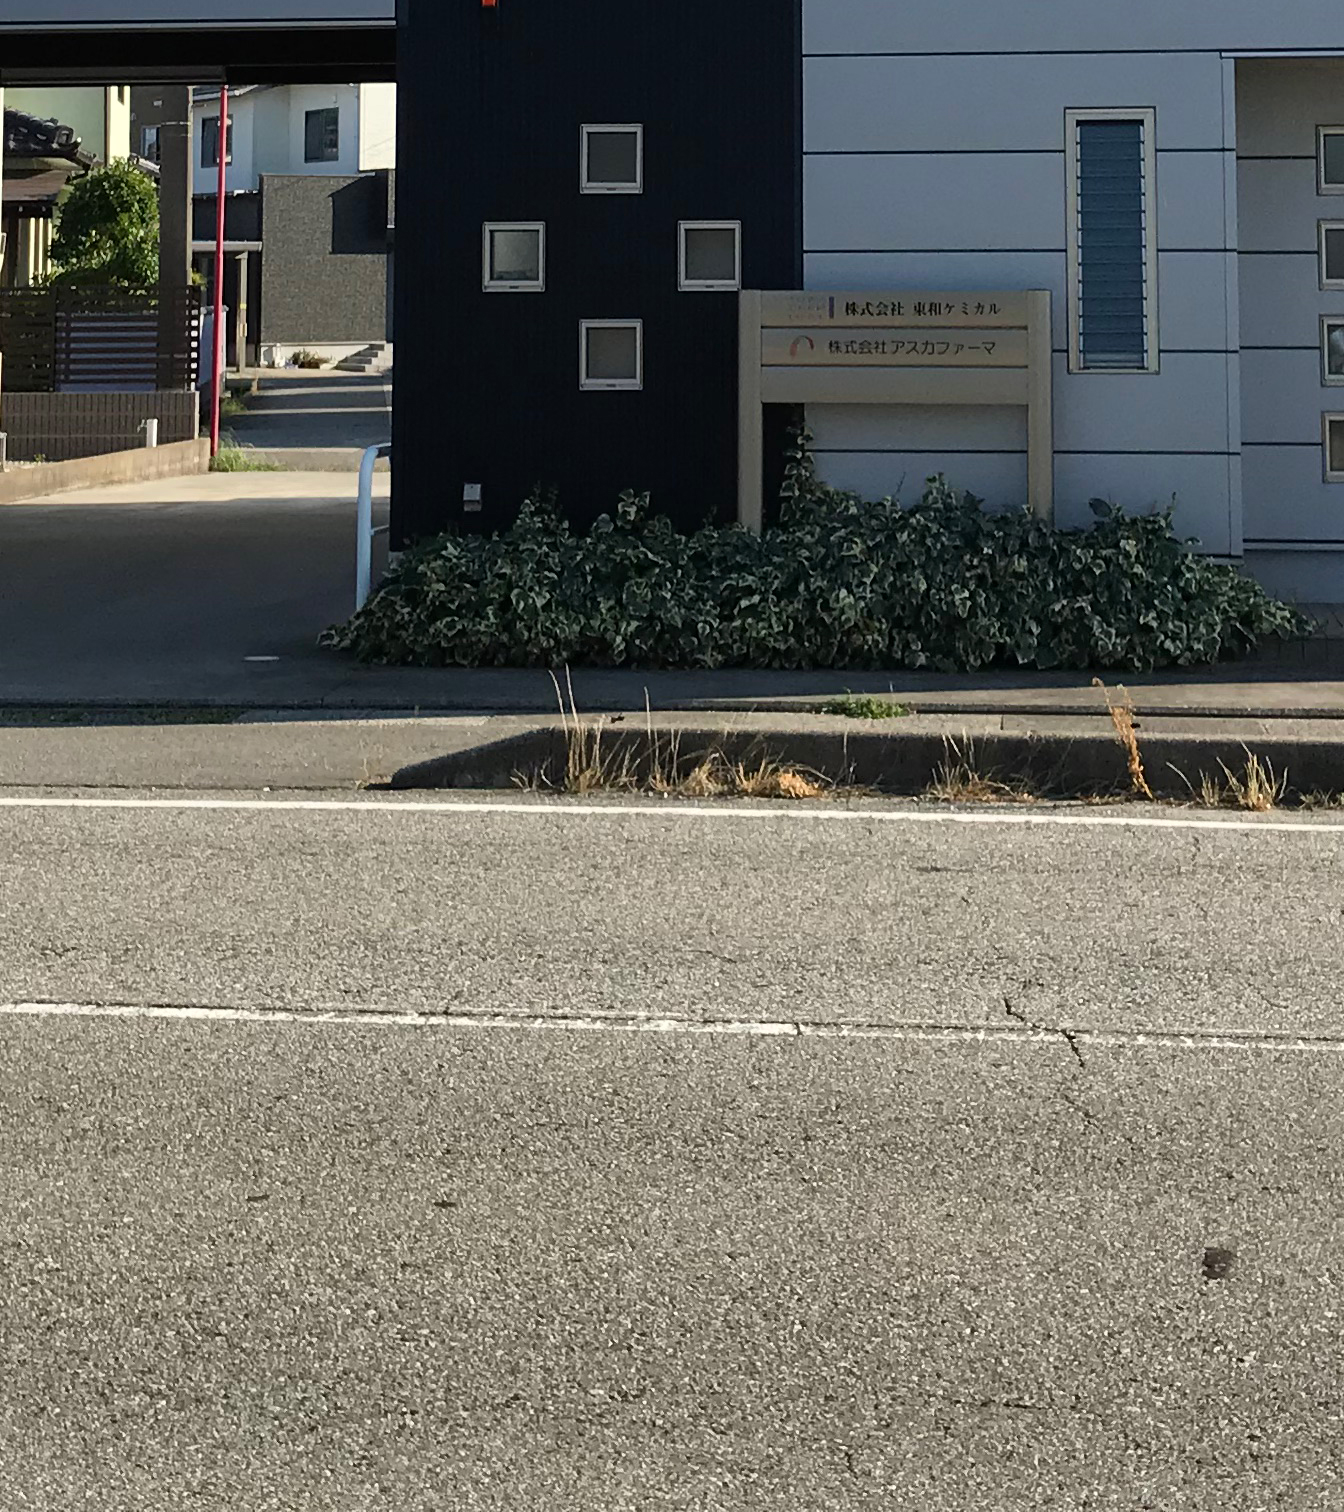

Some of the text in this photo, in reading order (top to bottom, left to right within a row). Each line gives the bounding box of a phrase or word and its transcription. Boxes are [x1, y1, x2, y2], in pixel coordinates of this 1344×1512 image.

[845, 301, 1002, 317] 株式会社 東和ケミカル
